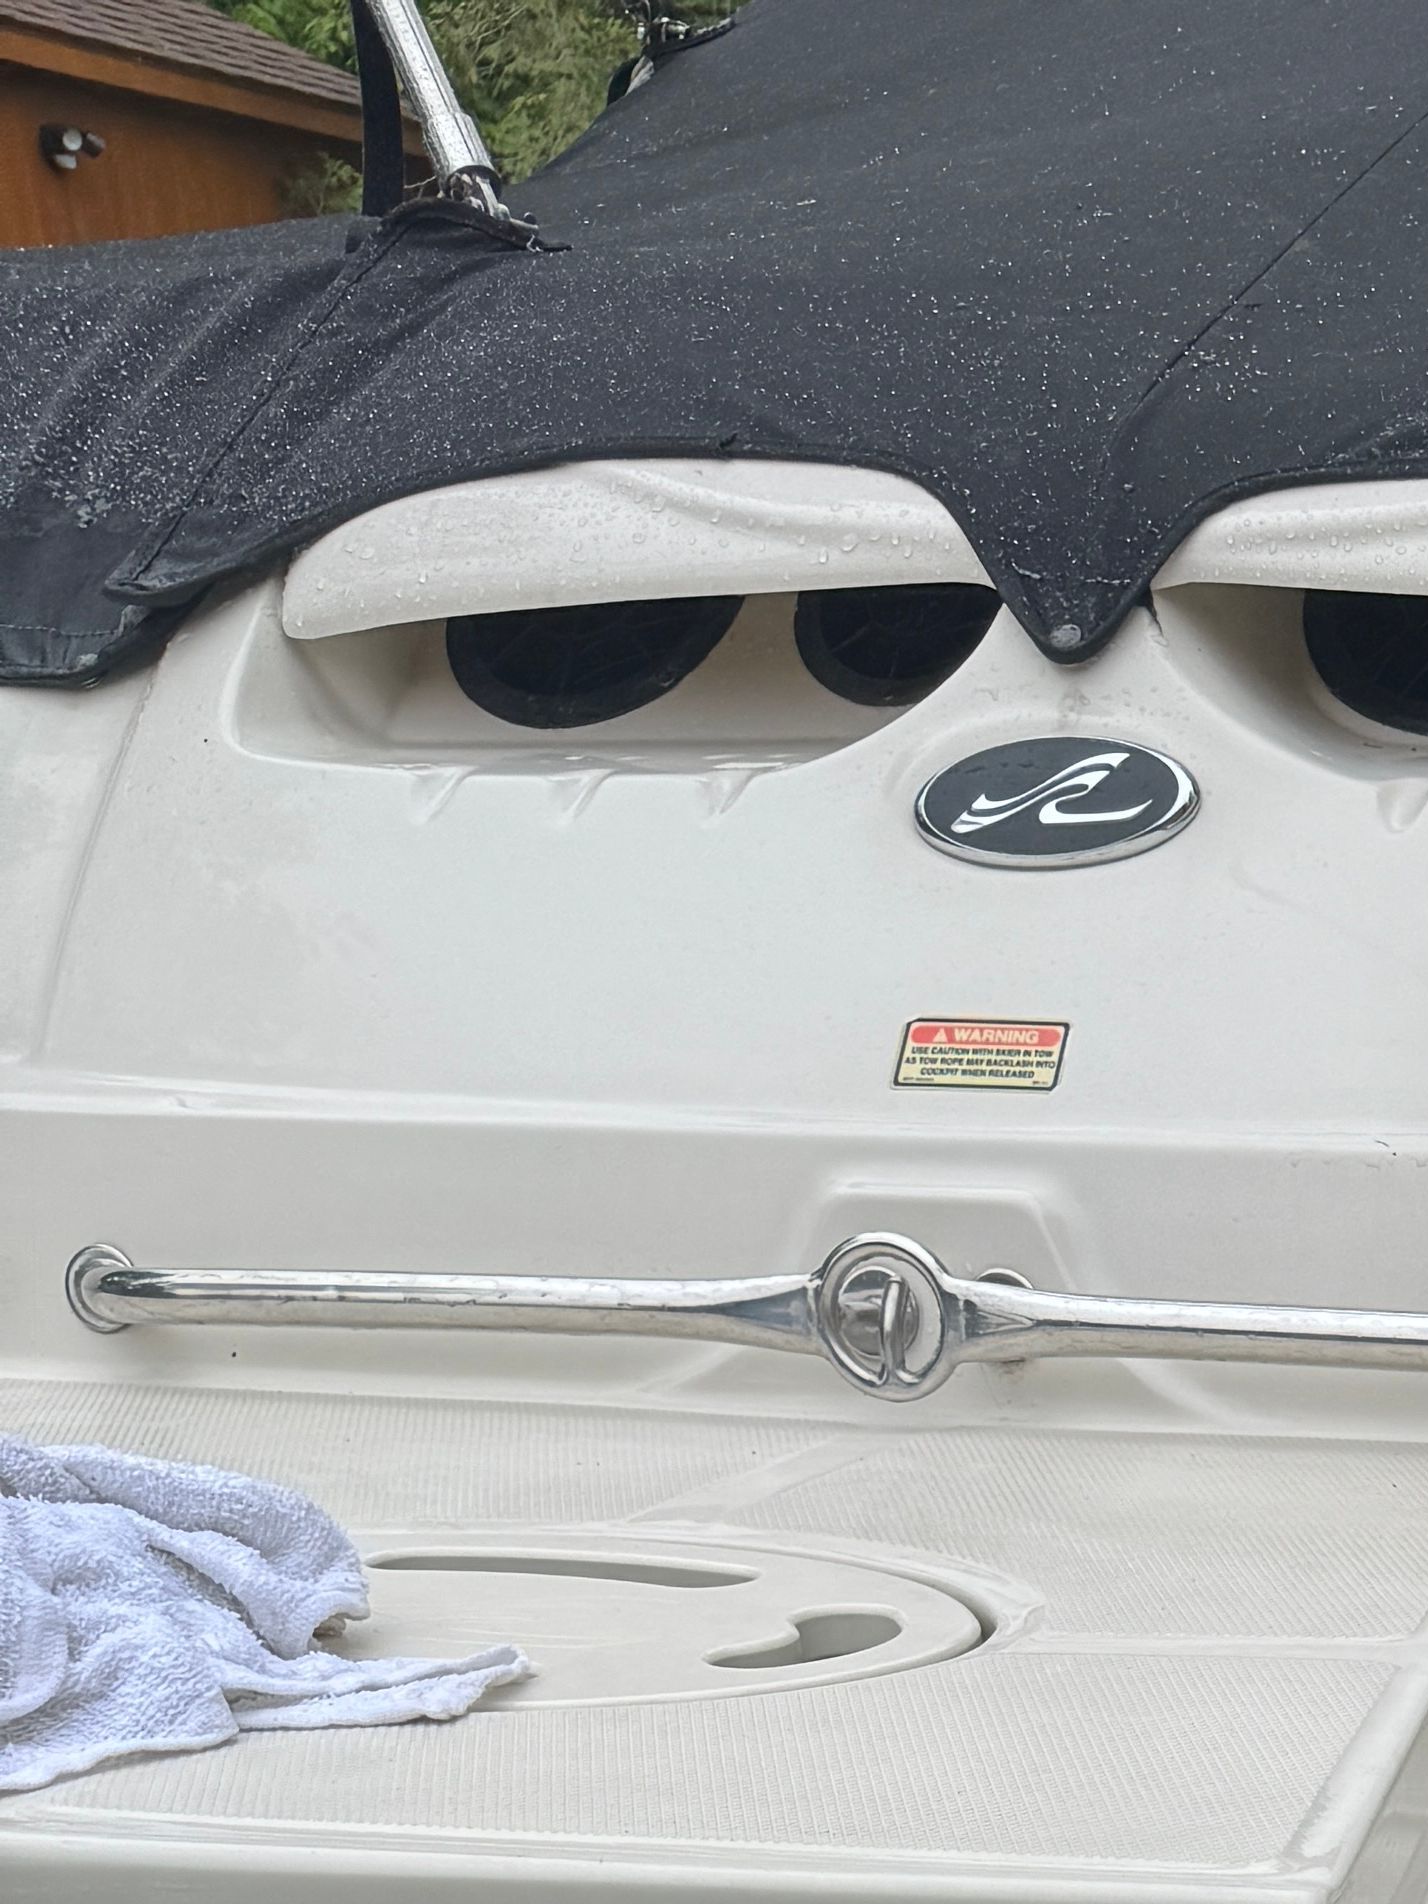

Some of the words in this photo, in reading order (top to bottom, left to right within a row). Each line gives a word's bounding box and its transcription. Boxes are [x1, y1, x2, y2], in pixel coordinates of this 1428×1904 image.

[954, 1028, 1039, 1043] WARNING
[911, 1046, 928, 1054] USE
[931, 1047, 969, 1055] CAUTION
[1034, 1050, 1054, 1058] TOW
[919, 1057, 938, 1065] TOW
[940, 1058, 964, 1066] ROPE
[986, 1059, 1033, 1067] BACKLASH
[1035, 1060, 1056, 1068] INTO
[920, 1068, 958, 1076] COCKPIT
[960, 1069, 987, 1077] WHEN
[989, 1069, 1035, 1078] RELEASED
